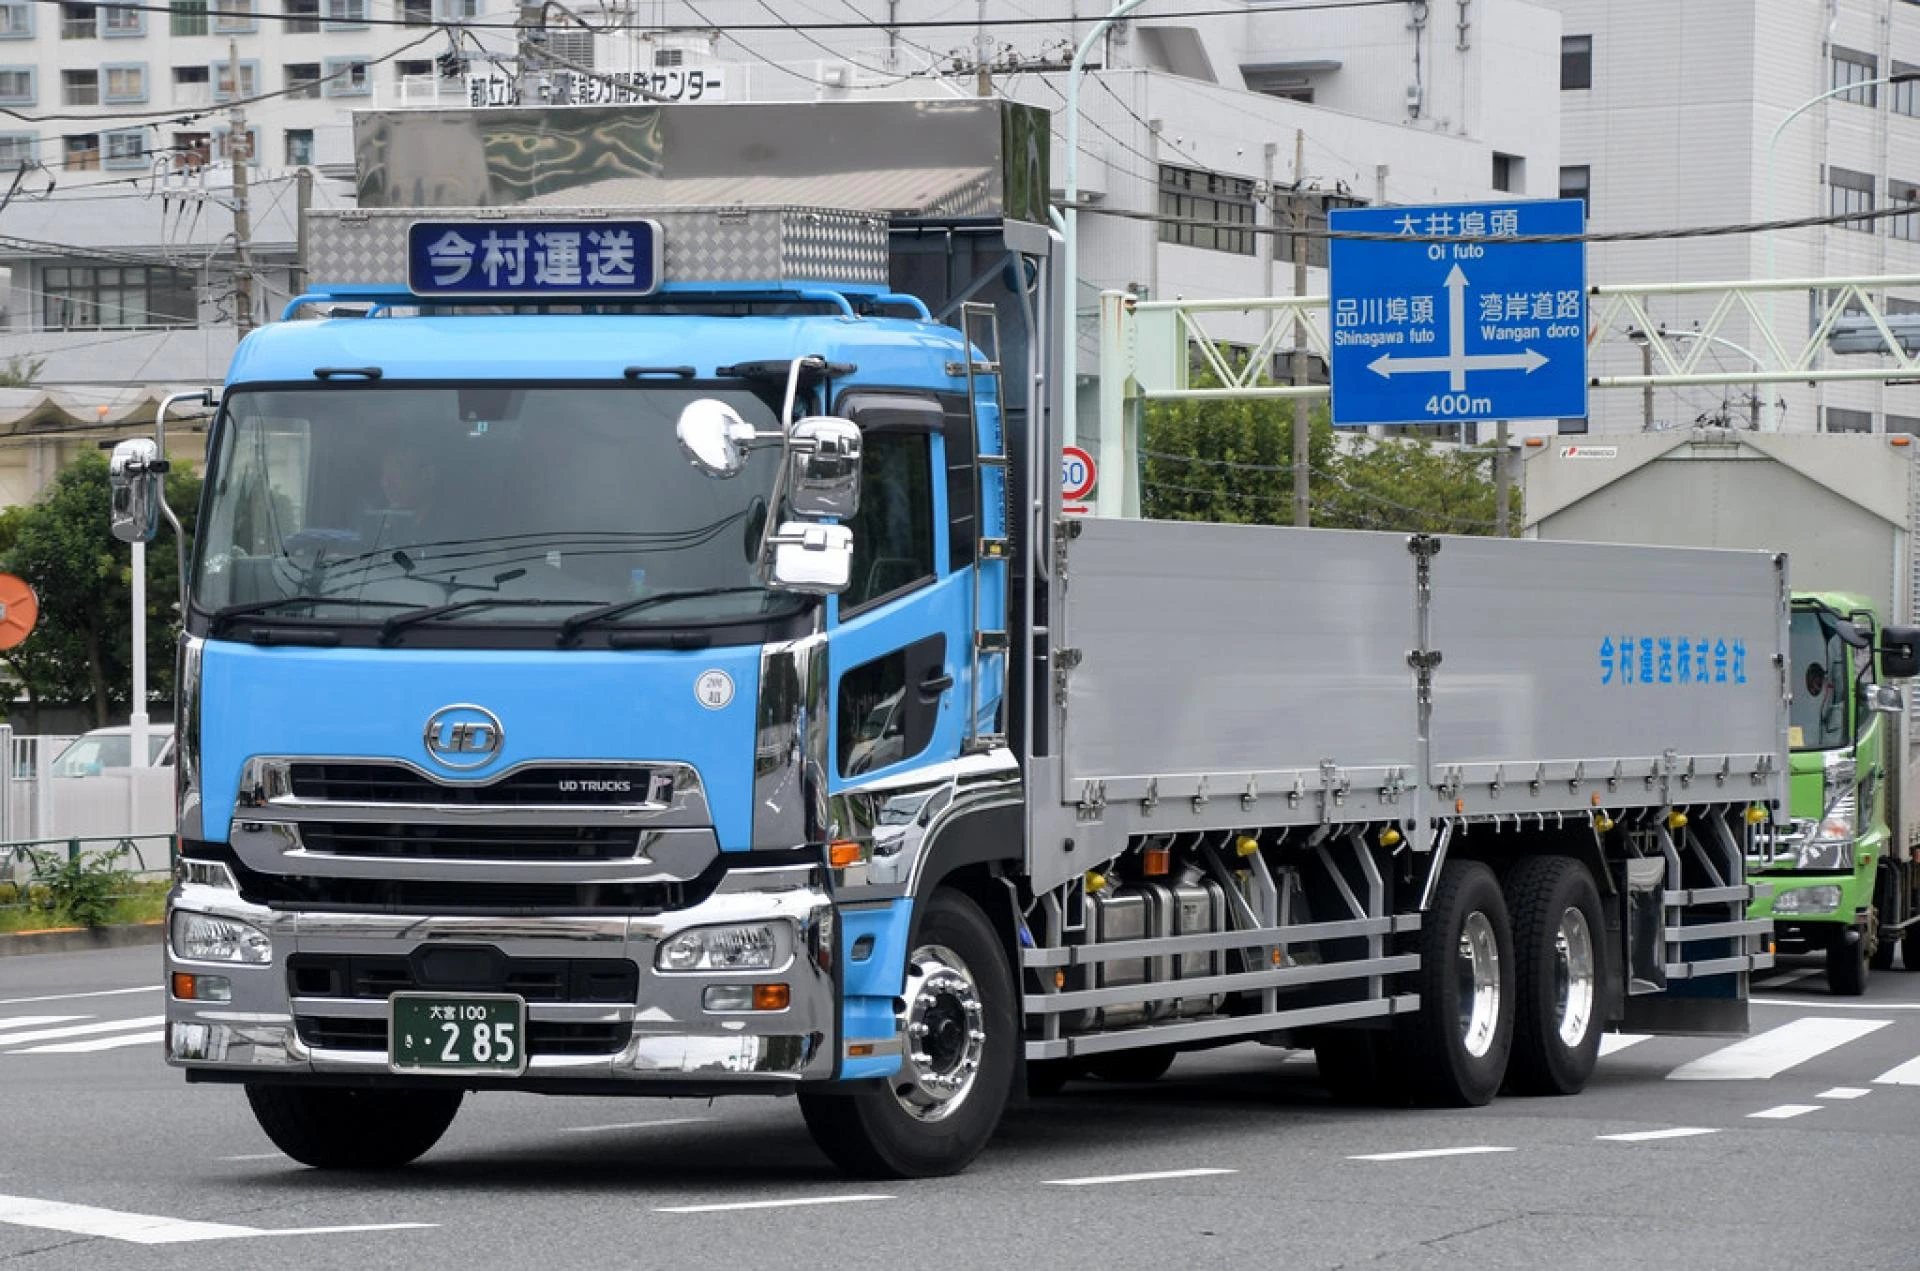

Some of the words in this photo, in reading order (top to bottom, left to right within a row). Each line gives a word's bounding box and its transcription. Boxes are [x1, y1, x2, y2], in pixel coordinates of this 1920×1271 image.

[1393, 209, 1519, 238] 大井埠頭
[427, 230, 635, 286] 今村運送
[1428, 244, 1446, 260] Oi
[1453, 243, 1484, 259] futo
[1336, 295, 1434, 327] 品川埠頭
[1479, 290, 1580, 322] 湾岸道路
[1334, 330, 1404, 347] Shinagawa
[1410, 327, 1435, 342] futo
[1480, 325, 1540, 342] Wangan
[1546, 323, 1580, 338] doro
[1425, 395, 1492, 415] 400m
[1600, 635, 1747, 685] 今村運送株式会社
[429, 722, 496, 753] UD
[559, 781, 577, 792] UD
[580, 781, 631, 792] TRUCKS
